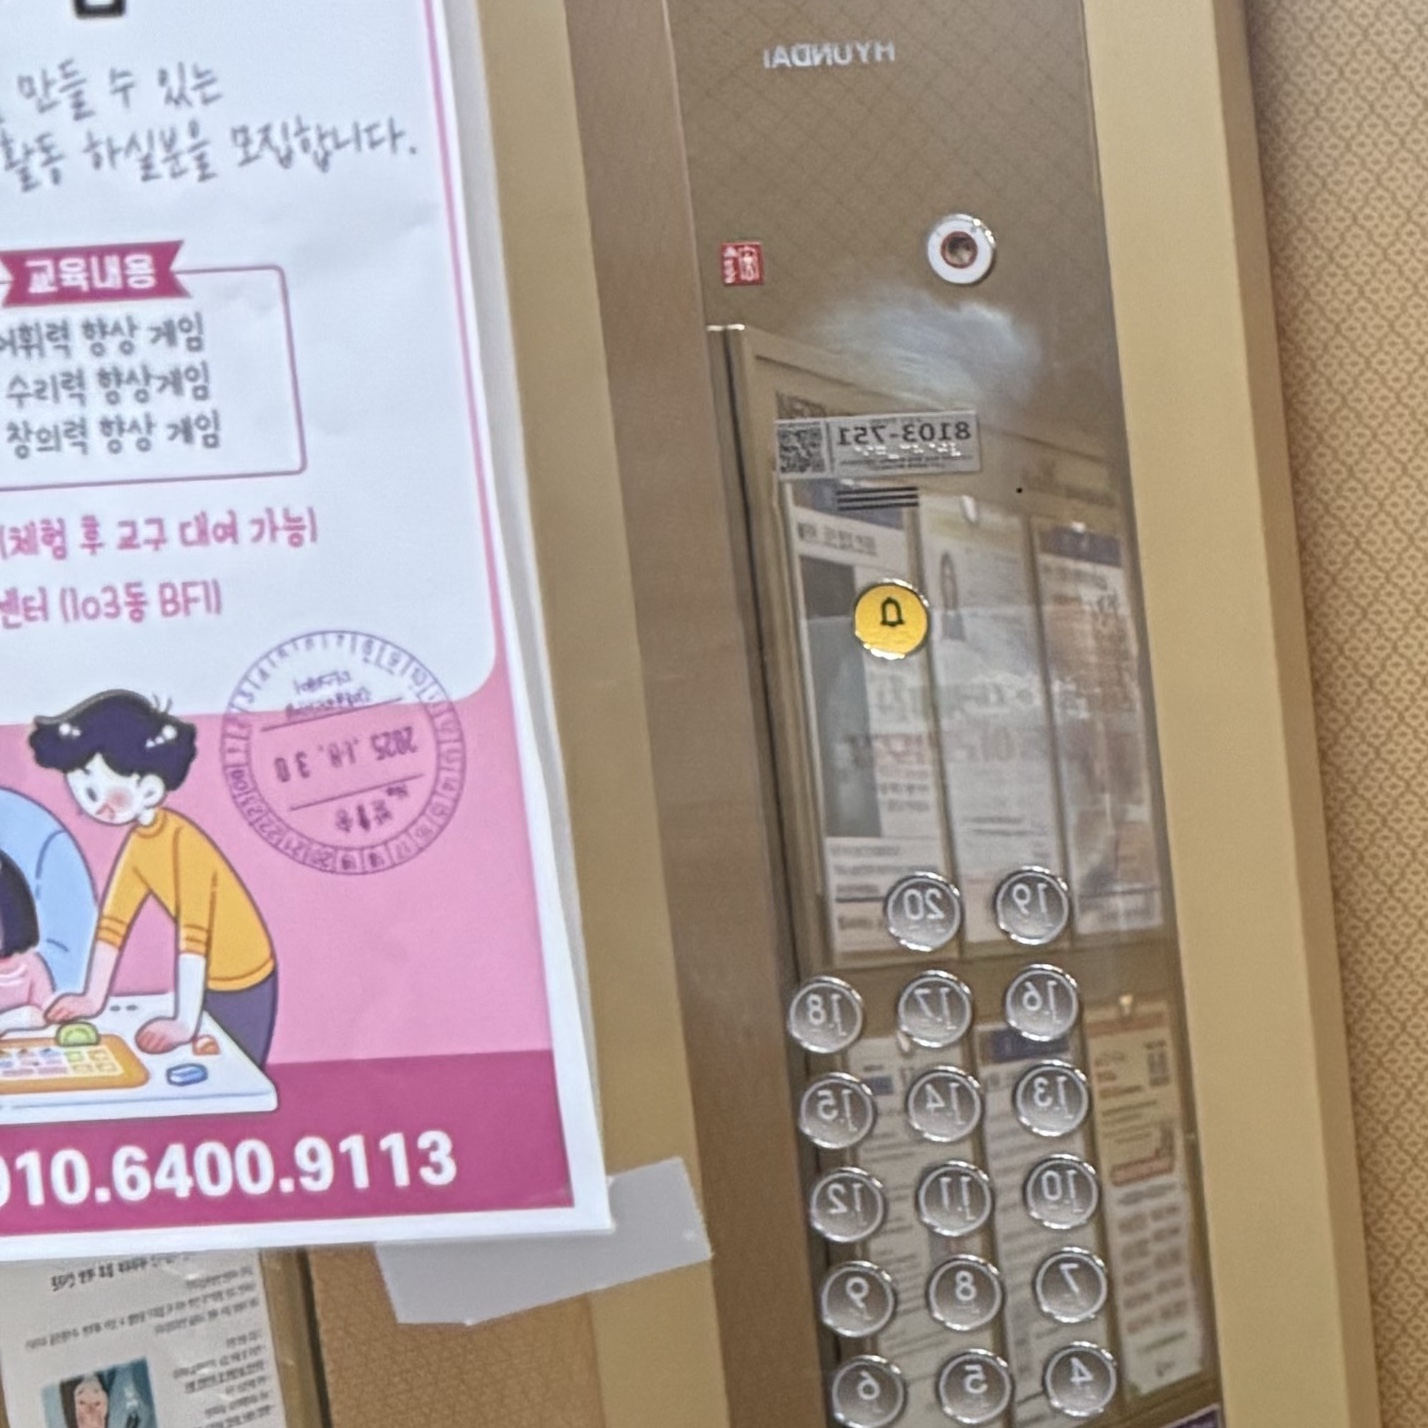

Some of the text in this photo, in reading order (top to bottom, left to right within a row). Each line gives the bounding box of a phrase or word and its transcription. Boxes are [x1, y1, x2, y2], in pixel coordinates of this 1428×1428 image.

[17, 57, 223, 121] 만들 수 있는
[82, 118, 218, 183] 하실분을
[230, 115, 420, 176] 모집합니다.
[24, 253, 158, 295] 교육내용
[149, 312, 206, 353] 게임
[6, 367, 86, 410] 수리력
[156, 363, 211, 402] 게임
[7, 415, 88, 460] 창의력
[166, 411, 222, 450] 게임
[0, 507, 318, 561] (체험 후 교구 대여 가능)
